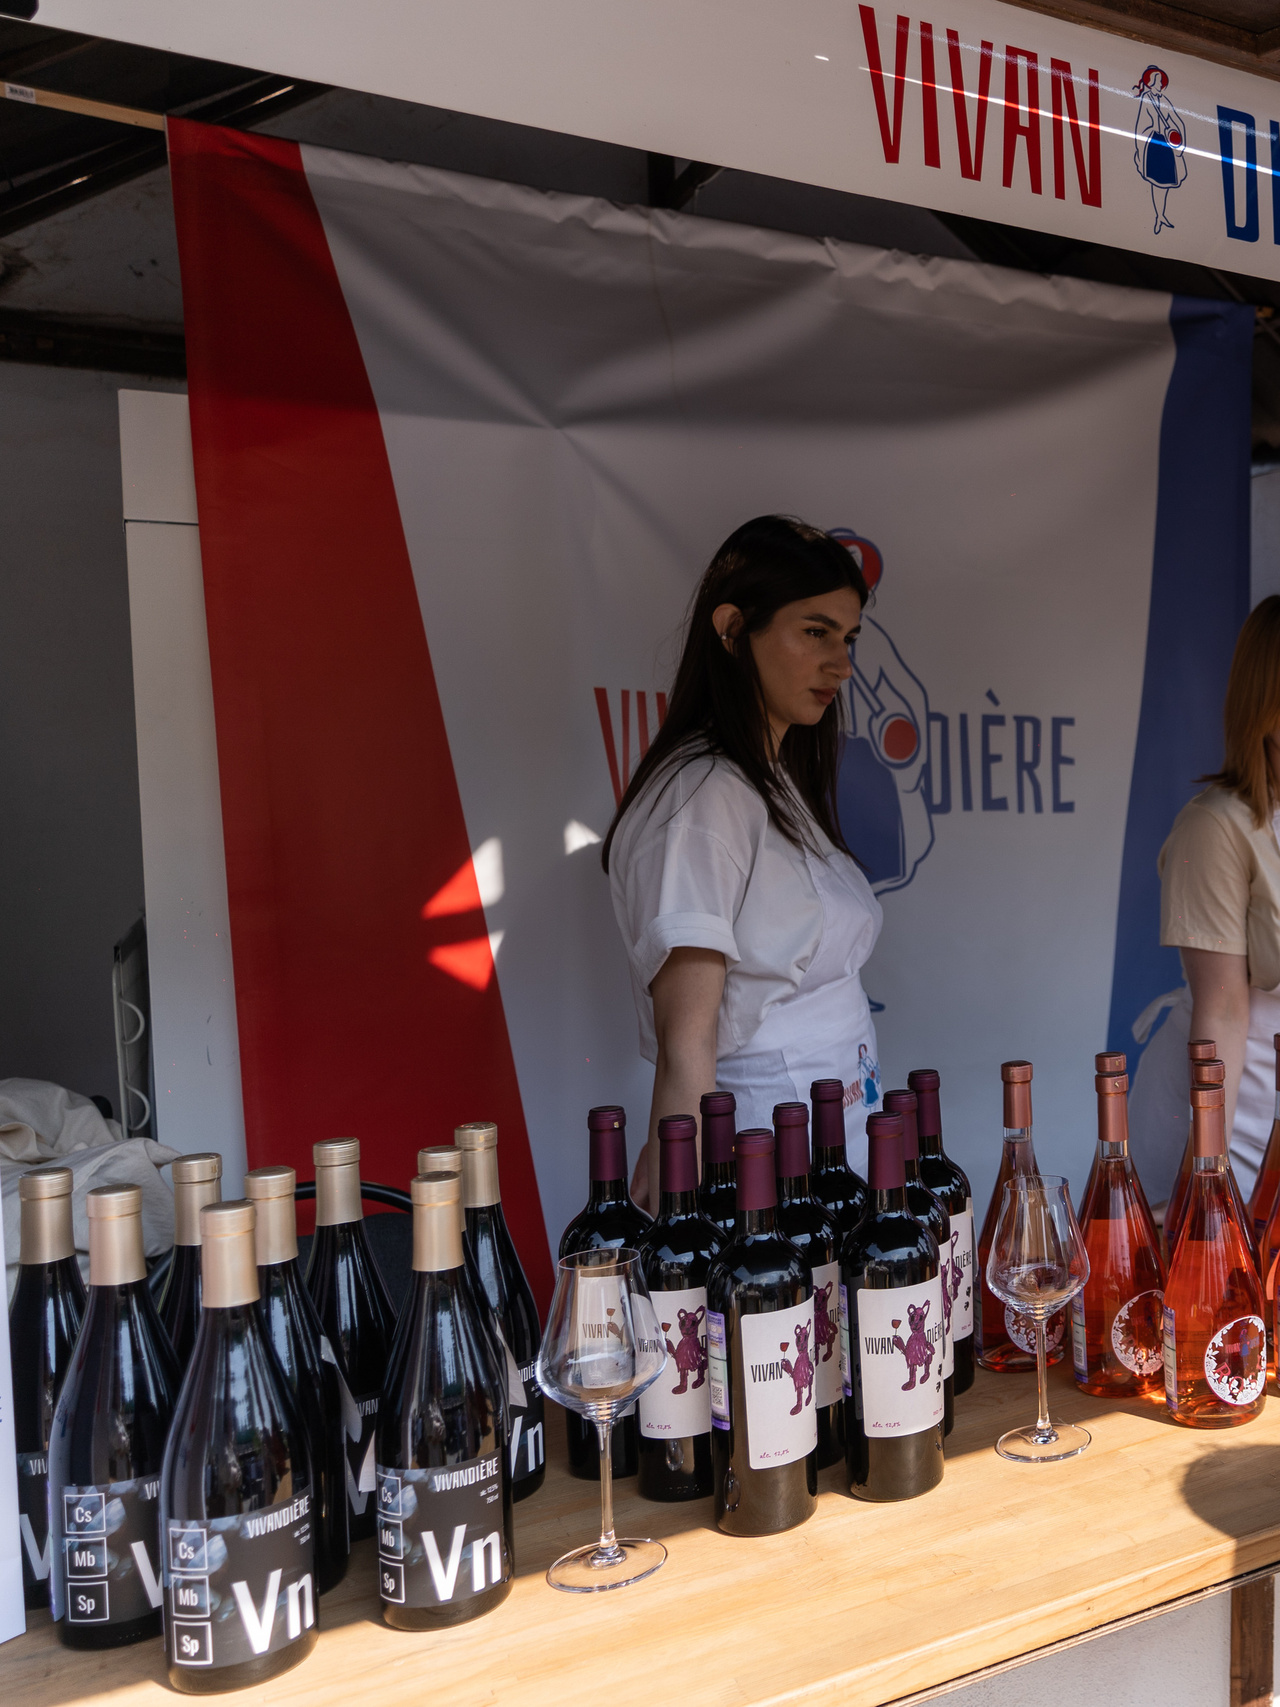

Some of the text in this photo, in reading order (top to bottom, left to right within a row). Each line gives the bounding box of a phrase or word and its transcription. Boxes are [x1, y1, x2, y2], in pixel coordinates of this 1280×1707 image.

[858, 4, 1102, 208] VIVAN
[928, 689, 1076, 815] DIÈRE
[582, 1323, 610, 1339] VIVAN
[865, 1336, 895, 1356] VIVAN
[751, 1361, 783, 1384] VIVAN
[434, 1456, 499, 1492] VIVANDIÈRE
[381, 1486, 393, 1505] Cs
[75, 1506, 92, 1523] Cs
[246, 1494, 311, 1539] VIVANDIÈRE
[381, 1529, 395, 1548] Mb
[75, 1551, 96, 1568] Mb
[178, 1541, 195, 1560] Cs
[421, 1523, 503, 1602] Vn
[383, 1572, 395, 1594] Sp
[78, 1595, 96, 1614] Sp
[178, 1588, 199, 1607] Mb
[231, 1568, 315, 1655] Vn
[181, 1634, 200, 1657] Sp
